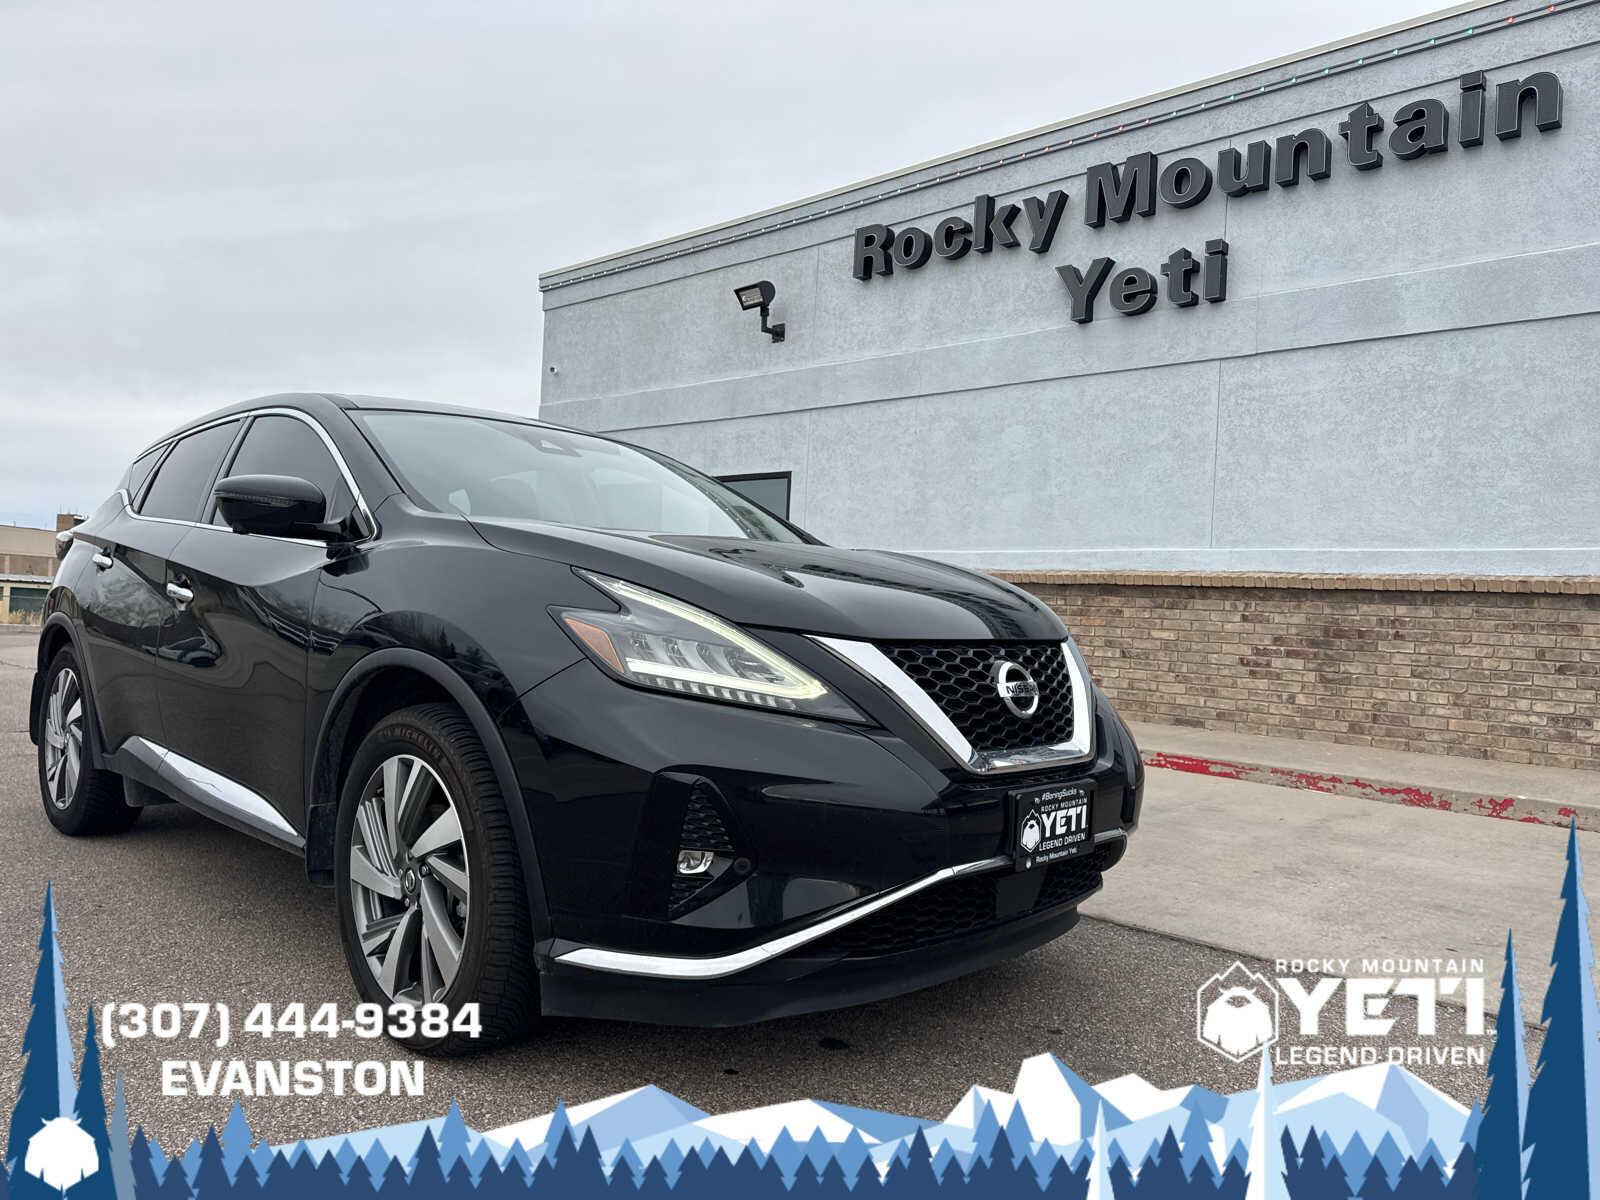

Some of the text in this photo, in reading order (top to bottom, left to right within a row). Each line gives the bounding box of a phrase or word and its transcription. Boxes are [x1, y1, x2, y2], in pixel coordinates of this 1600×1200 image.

[852, 70, 1563, 281] Rocky Mountain
[1056, 238, 1229, 324] Yeti
[1041, 797, 1088, 812] ROCKY MOUNTAIN
[1041, 805, 1087, 838] YETI
[1039, 832, 1086, 851] LEGEND DRIVEN
